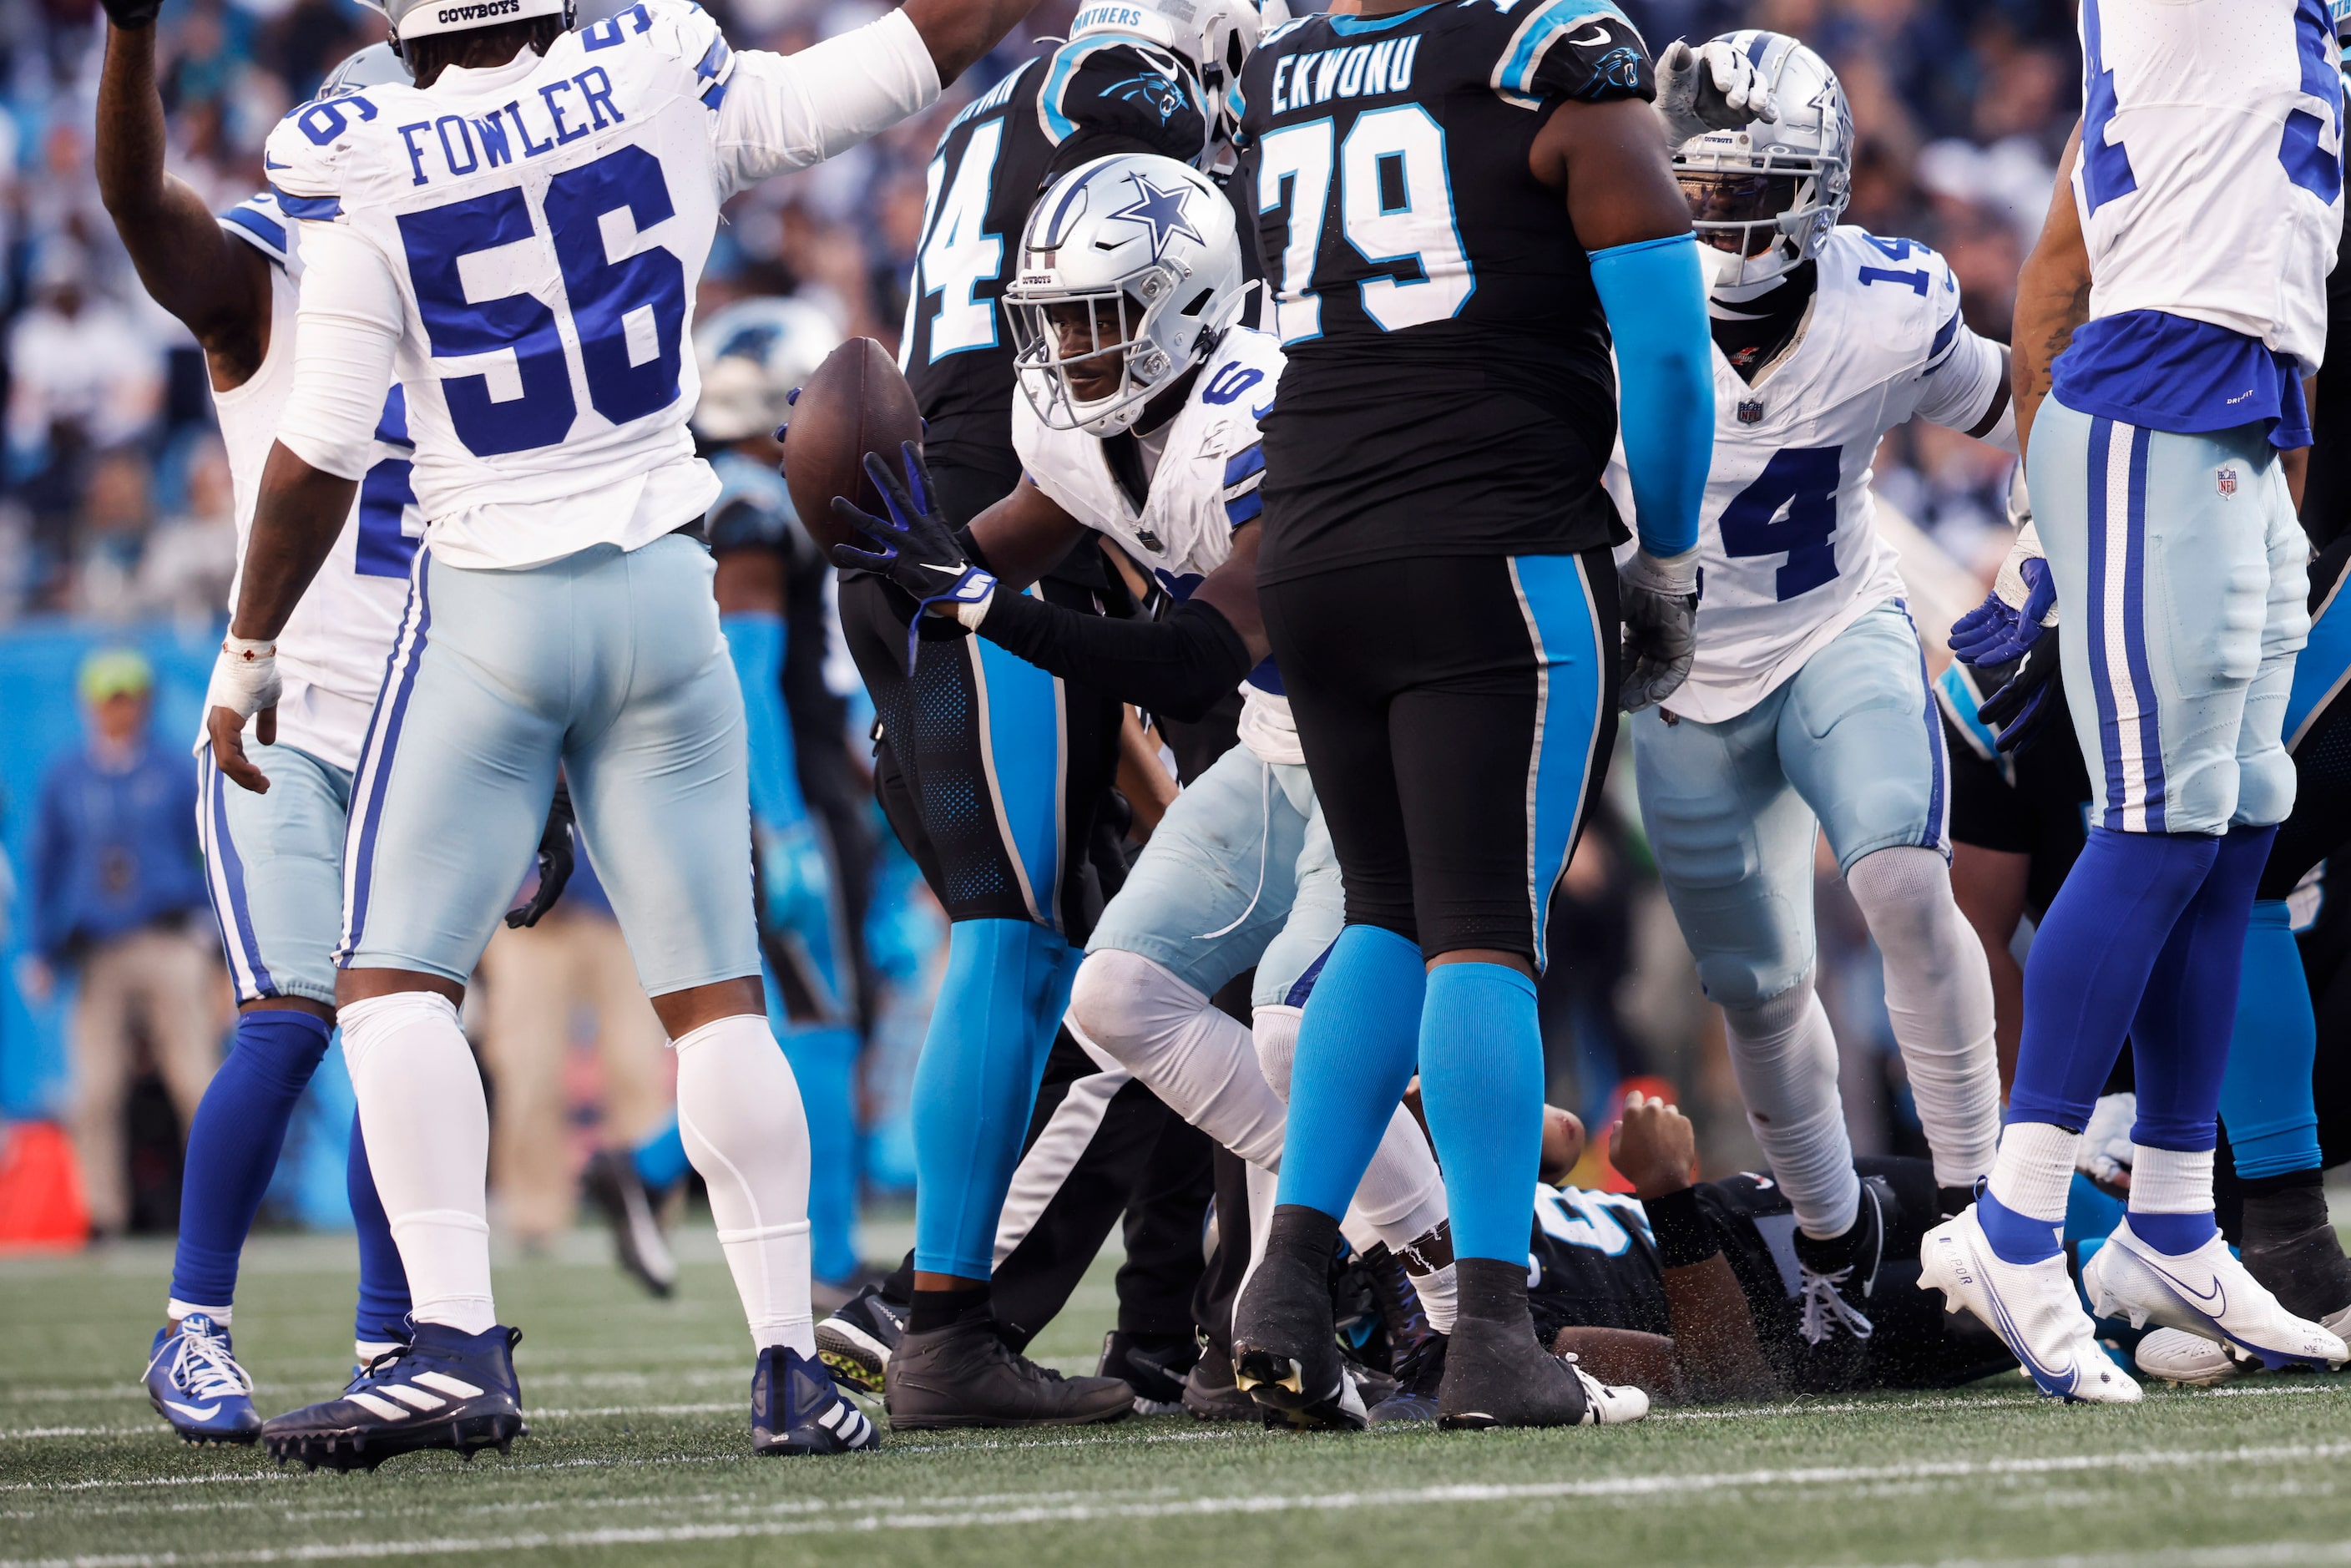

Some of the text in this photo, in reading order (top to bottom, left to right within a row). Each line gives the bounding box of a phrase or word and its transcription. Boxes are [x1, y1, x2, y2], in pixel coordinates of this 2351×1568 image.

[438, 0, 519, 23] COWBOYS
[1072, 8, 1141, 38] PANTHERS
[1272, 33, 1422, 115] EKWONU
[398, 65, 624, 186] FOWLER
[1258, 101, 1476, 347] 79
[397, 144, 685, 458] 56
[1022, 276, 1051, 285] COWBOYS
[1202, 361, 1265, 406] 6
